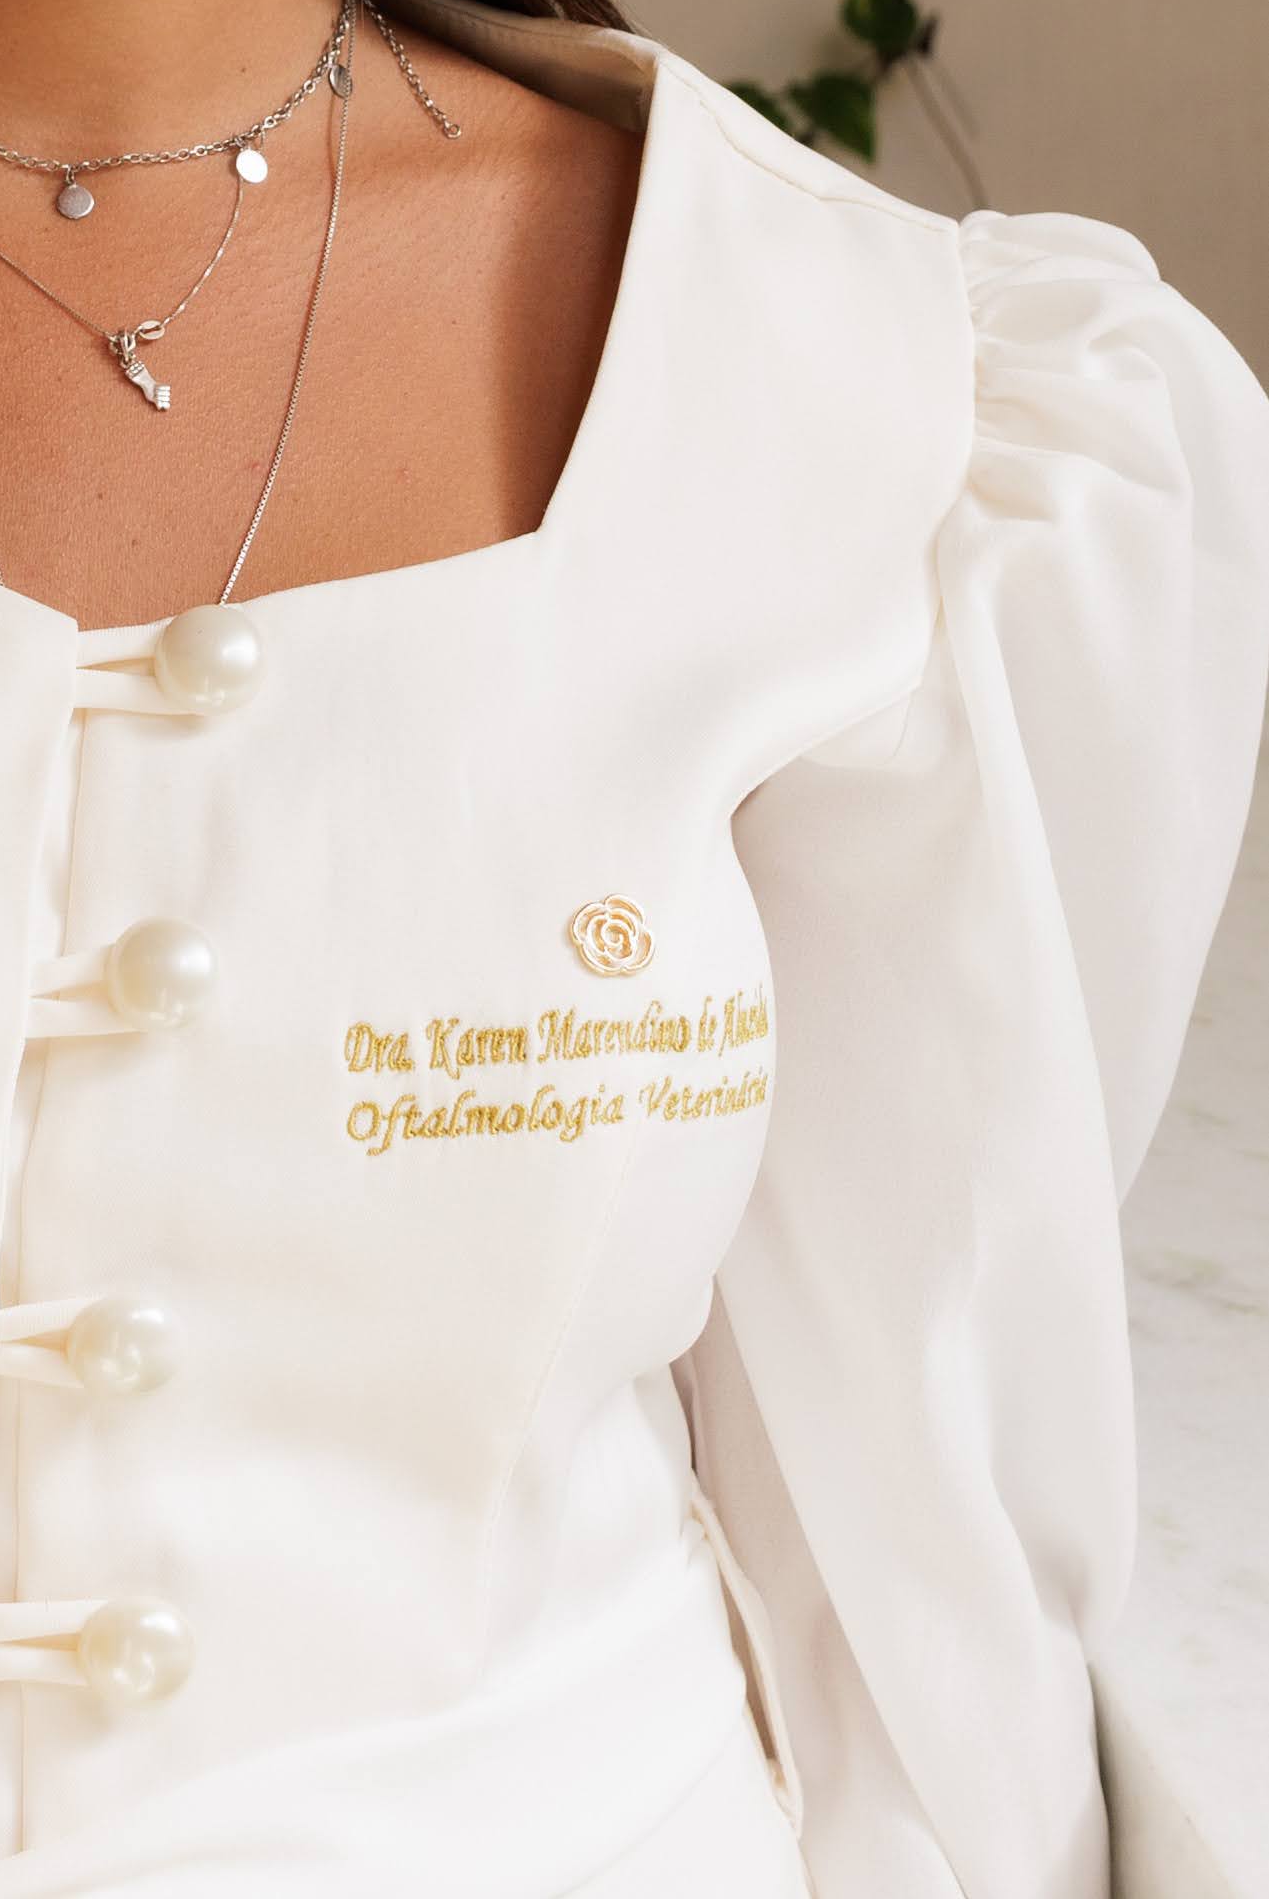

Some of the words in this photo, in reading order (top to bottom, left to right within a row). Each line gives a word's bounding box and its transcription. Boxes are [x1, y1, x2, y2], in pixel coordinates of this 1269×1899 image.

[344, 1021, 416, 1074] Dra.
[424, 1017, 529, 1080] Karen
[345, 1084, 626, 1156] Oftalmologia
